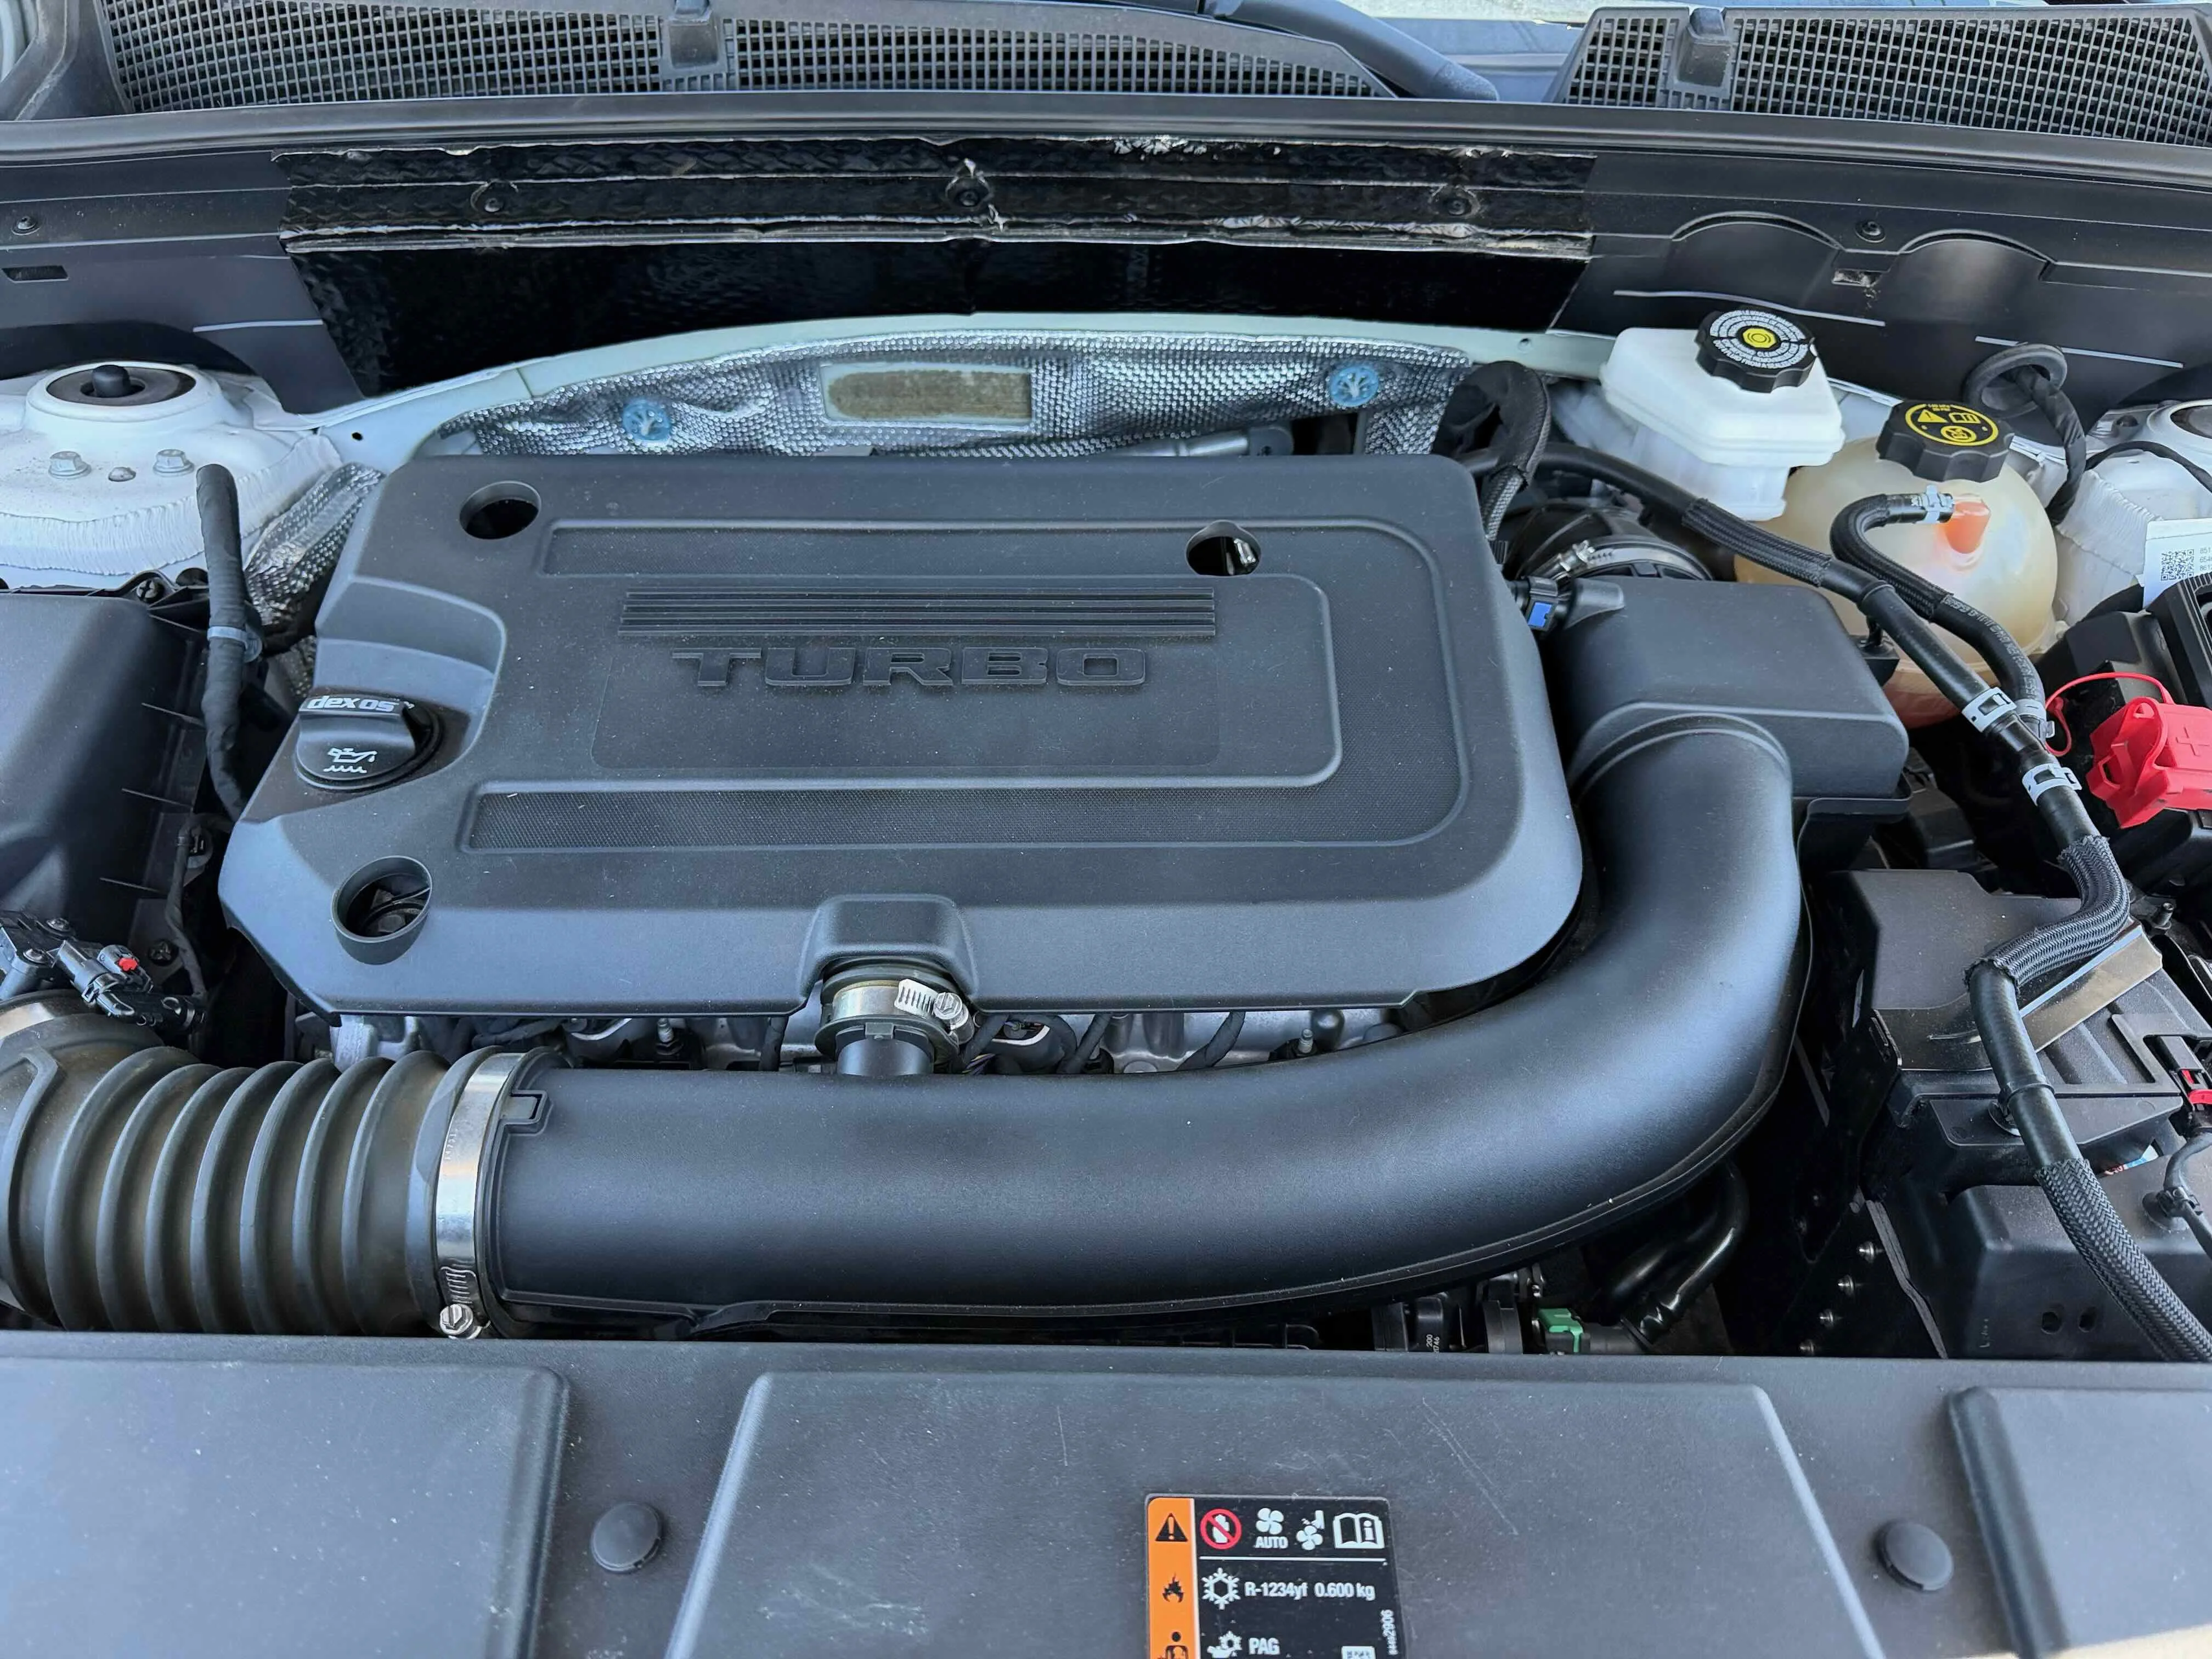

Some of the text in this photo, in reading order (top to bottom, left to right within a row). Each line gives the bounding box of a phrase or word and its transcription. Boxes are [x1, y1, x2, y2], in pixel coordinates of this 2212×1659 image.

[671, 646, 1146, 687] TURBO
[307, 695, 400, 712] dexos
[1254, 1536, 1289, 1549] AUTO
[1244, 1581, 1376, 1601] R-1234yf 0.600 kg
[1248, 1637, 1280, 1655] PAG
